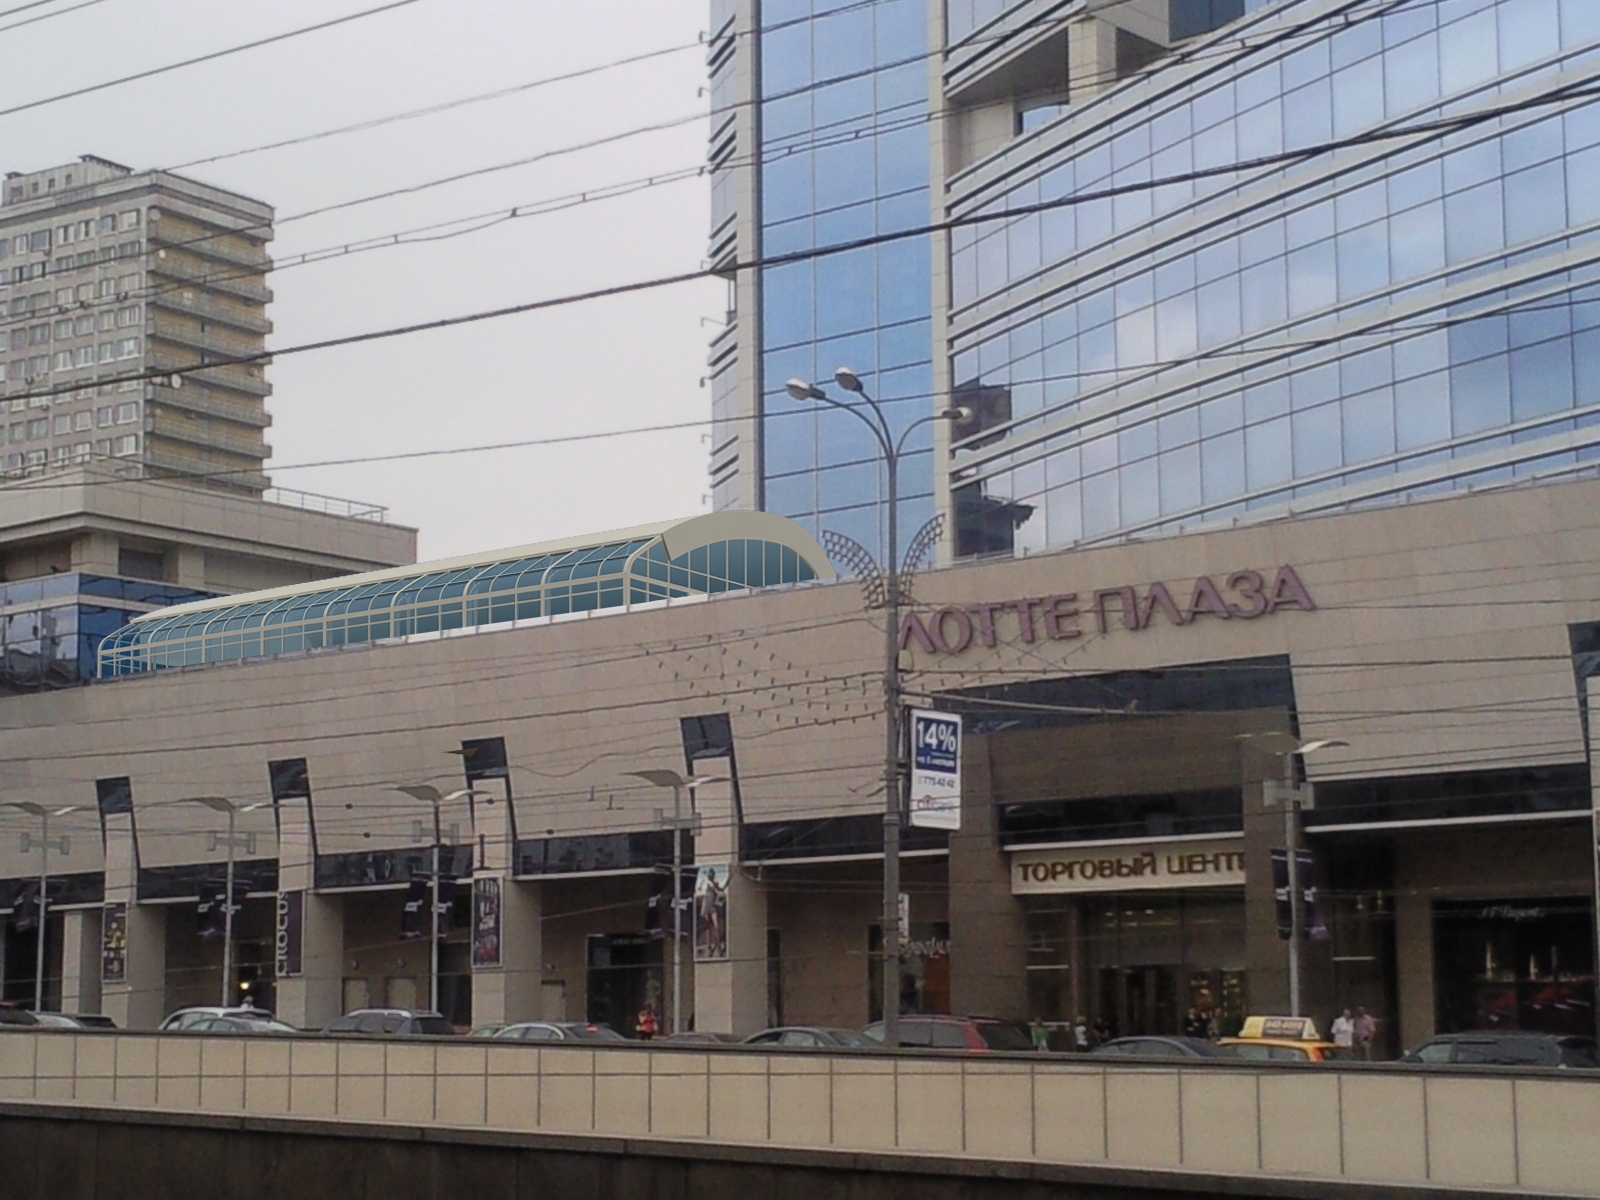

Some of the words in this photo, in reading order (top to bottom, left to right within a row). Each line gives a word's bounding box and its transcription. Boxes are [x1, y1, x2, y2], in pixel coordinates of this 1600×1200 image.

[899, 593, 1081, 655] ЛОТТЕ
[1092, 564, 1317, 634] ПЛАЗА
[917, 720, 957, 752] 14%
[1017, 852, 1158, 883] ТОРГОВЫЙ
